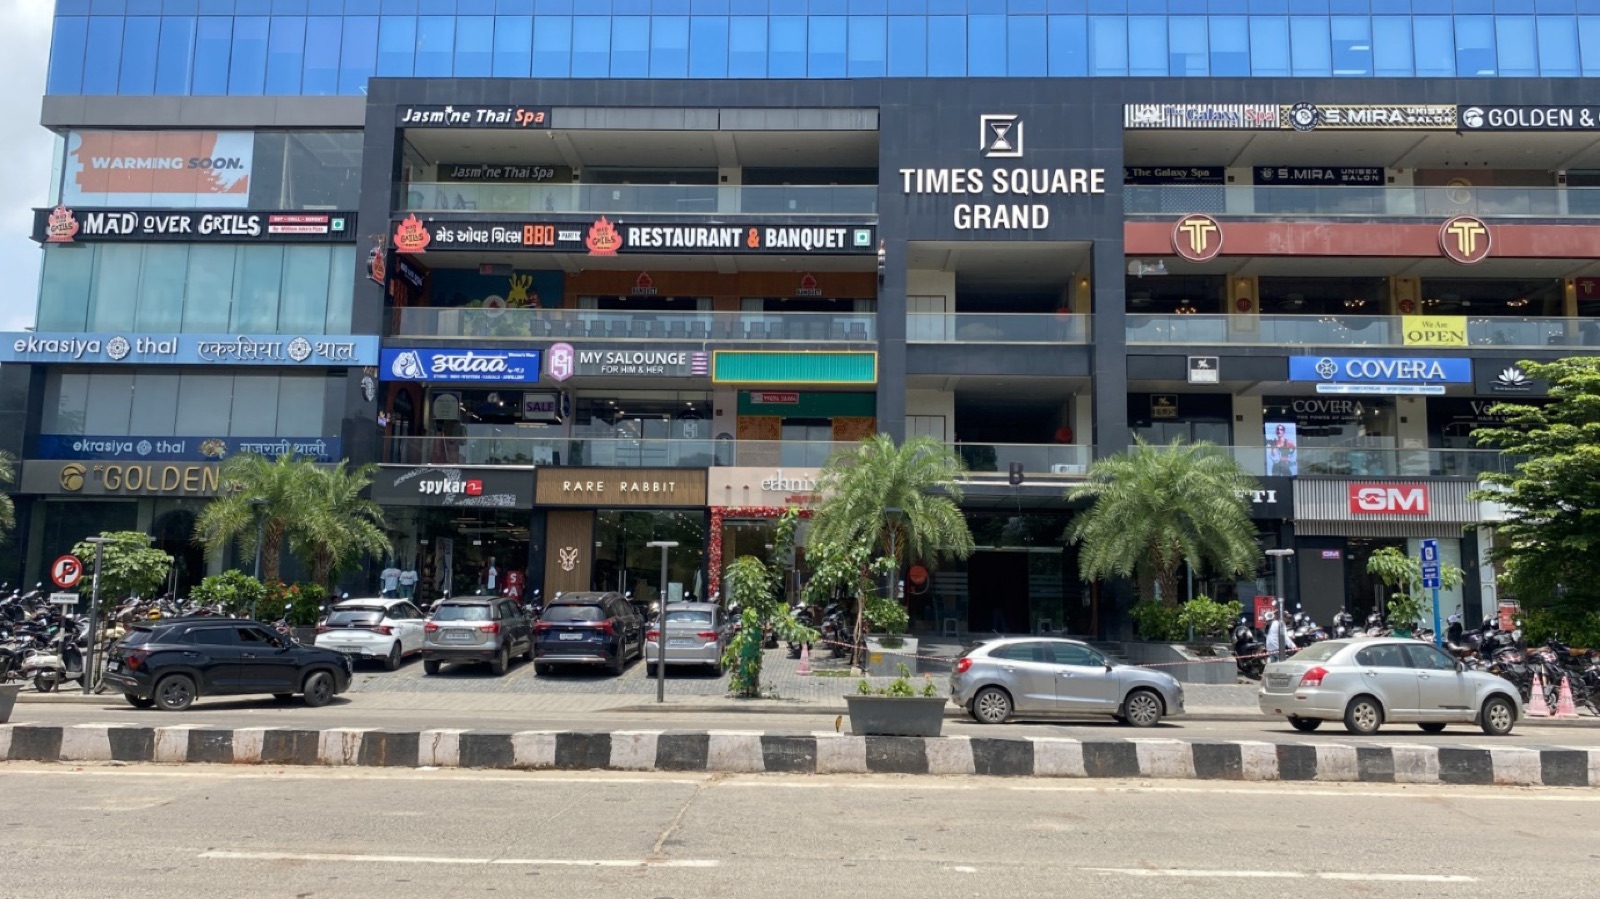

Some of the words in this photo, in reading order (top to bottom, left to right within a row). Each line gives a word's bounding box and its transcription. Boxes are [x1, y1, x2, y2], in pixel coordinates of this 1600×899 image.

[402, 105, 471, 125] Jasmine
[476, 108, 512, 123] Thai
[515, 109, 545, 126] Spa
[1186, 107, 1239, 124] Galaxy
[1245, 109, 1275, 125] Spa
[1325, 109, 1404, 123] S.MIRA
[1488, 108, 1574, 127] GOLDEN
[1579, 108, 1595, 127] &
[91, 156, 183, 169] WARMING
[187, 156, 244, 170] SOON.
[504, 166, 530, 179] Thai
[531, 166, 554, 181] Spa
[1133, 168, 1151, 177] The
[1154, 168, 1188, 178] Galaxy
[1277, 168, 1335, 180] S.MIRA
[899, 168, 984, 194] TIMES
[992, 168, 1105, 196] SQUARE
[84, 212, 138, 234] MAD
[144, 214, 191, 234] OVER
[953, 204, 1050, 230] GRAND
[523, 224, 555, 246] BBQ
[628, 226, 743, 248] RESTAURANT
[747, 226, 760, 248] &
[765, 227, 847, 251] BANQUET
[1422, 320, 1433, 329] We
[1407, 330, 1464, 343] OPEN
[13, 336, 101, 360] ekrasiya
[136, 336, 178, 354] thal
[197, 335, 285, 361] एकरसिया
[315, 341, 359, 361] थाल
[580, 352, 603, 364] MY
[605, 352, 686, 366] SALOUNGE
[601, 366, 618, 374] FOR
[621, 366, 636, 374] HIM
[637, 366, 643, 374] &
[646, 366, 664, 374] HER
[1346, 359, 1447, 380] COVERA
[526, 401, 554, 412] SALE
[1292, 400, 1366, 414] COVERA
[73, 439, 133, 454] ekrasiya
[157, 440, 186, 454] thal
[103, 465, 220, 492] GOLDEN
[418, 478, 466, 494] spykar
[562, 481, 604, 492] RARE
[620, 481, 676, 492] RABBIT
[1356, 487, 1426, 511] GM
[1322, 549, 1340, 558] GM
